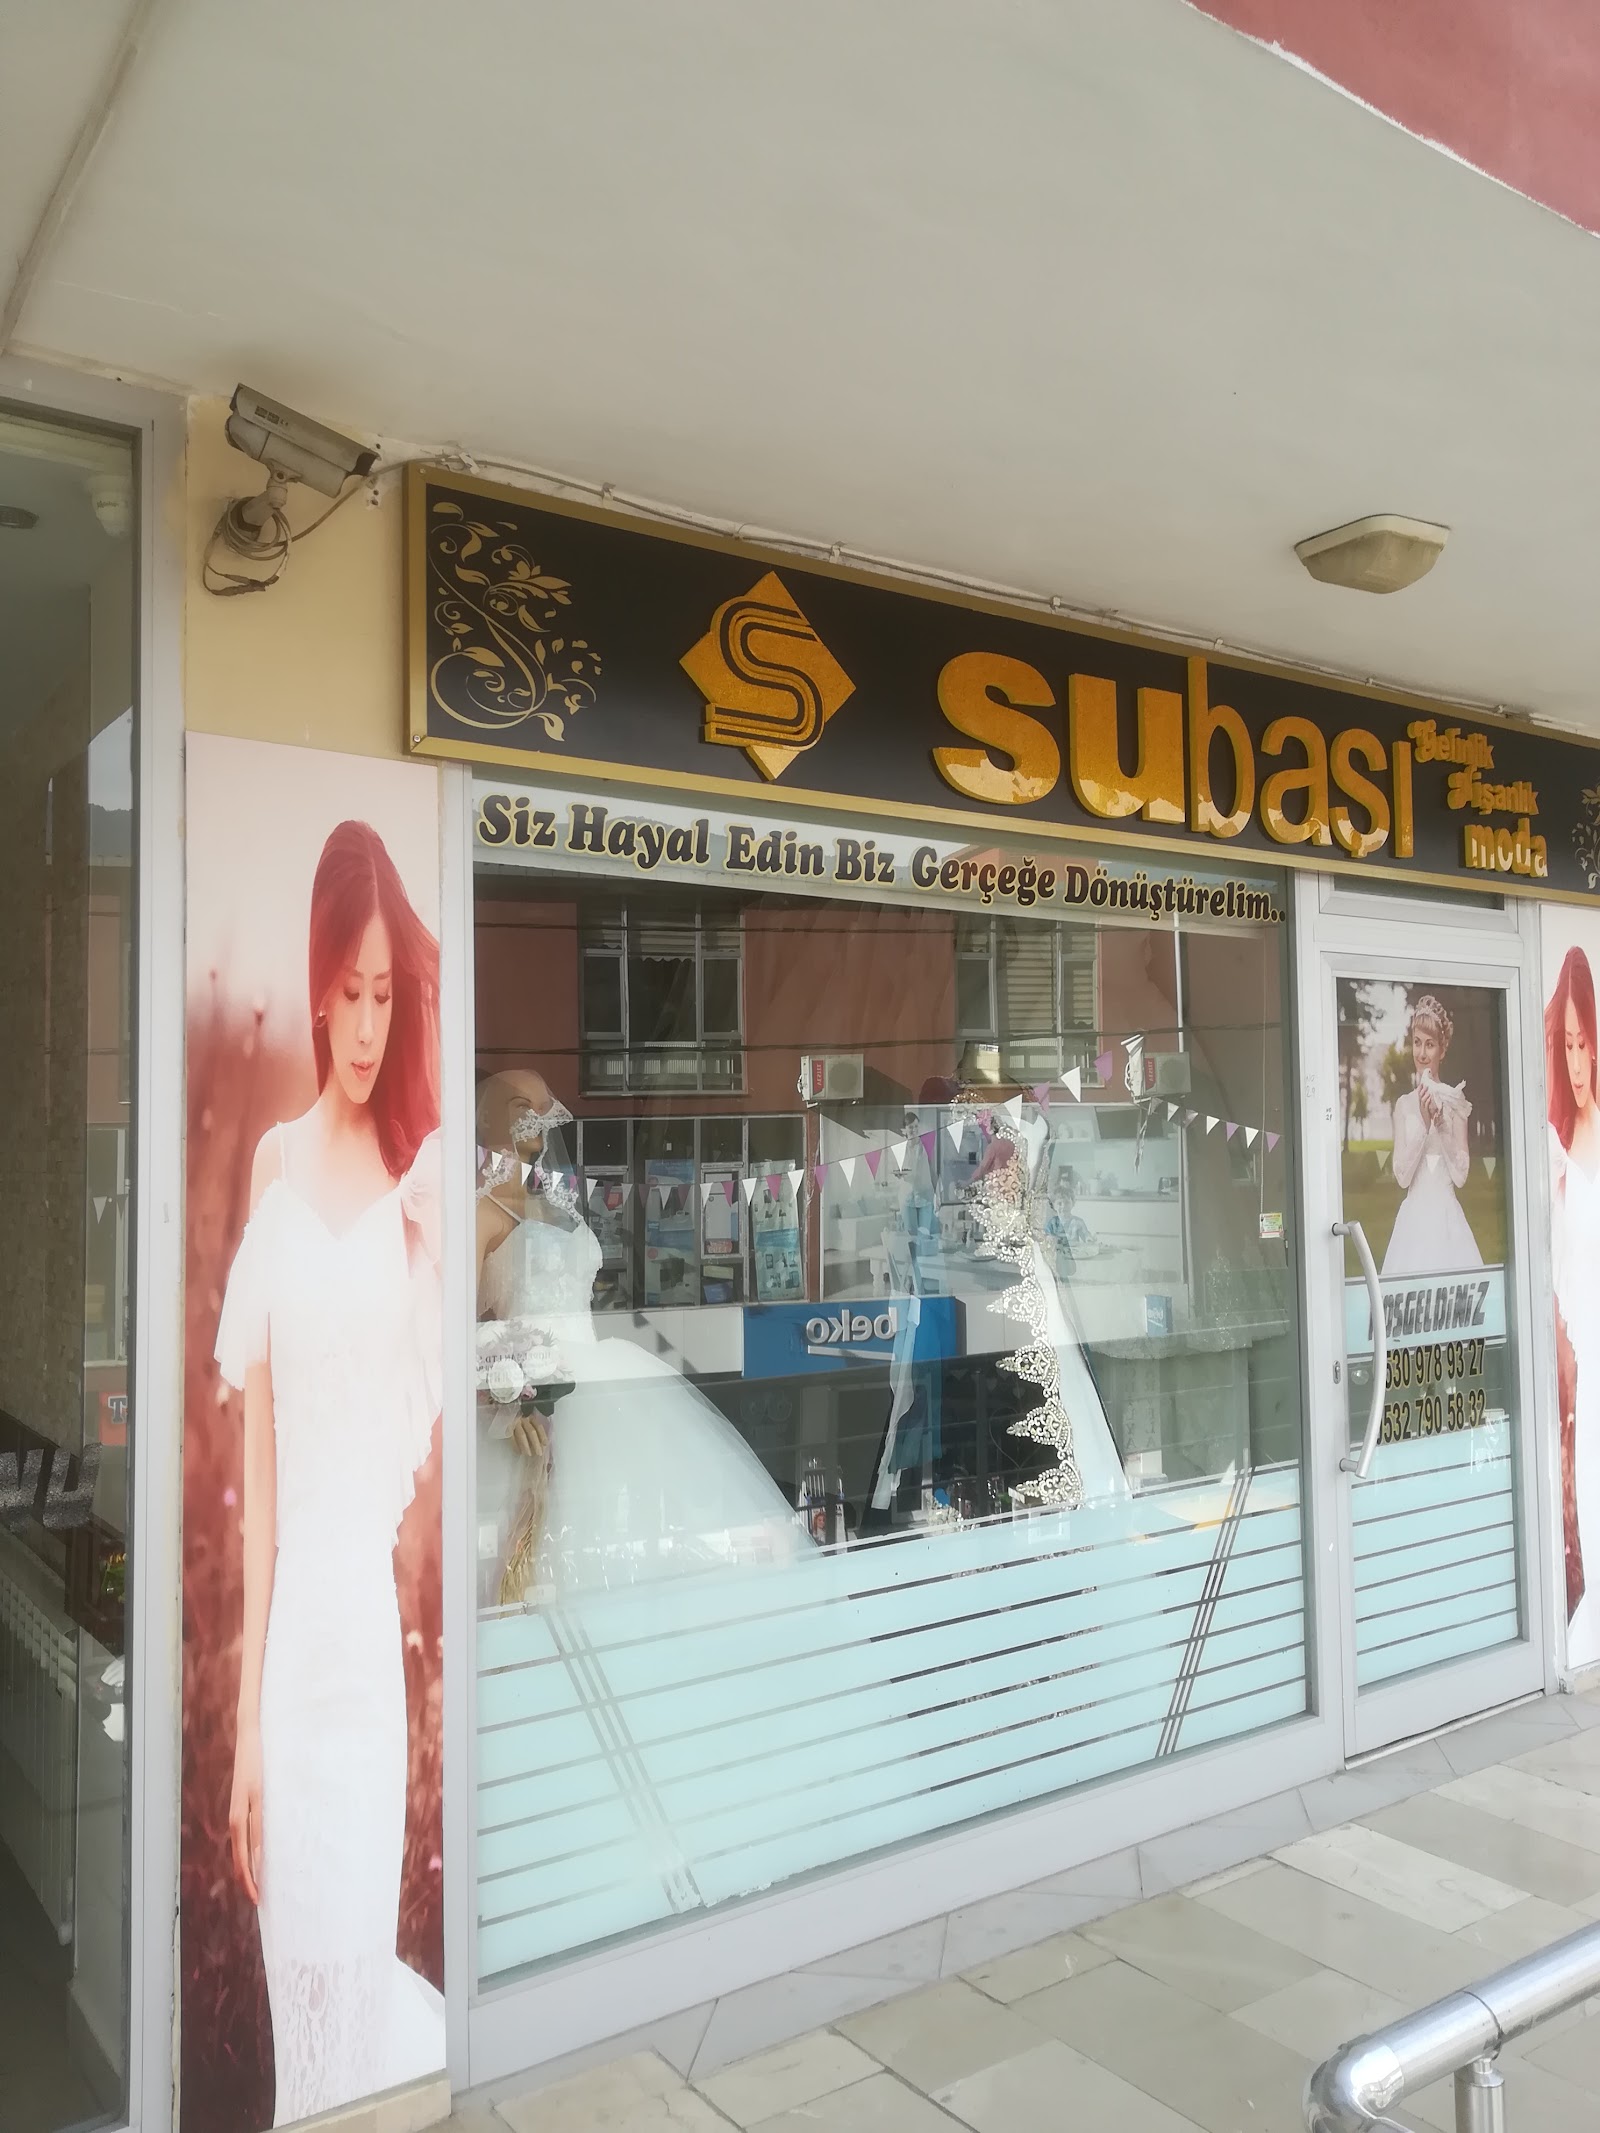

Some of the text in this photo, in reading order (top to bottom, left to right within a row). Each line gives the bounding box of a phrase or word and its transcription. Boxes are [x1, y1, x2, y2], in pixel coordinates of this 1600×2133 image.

[933, 651, 1415, 858] subaşı
[478, 793, 557, 846] Siz
[567, 803, 711, 870] Hayal
[725, 825, 825, 877] Edin
[834, 838, 896, 884] Biz
[912, 845, 1056, 906] Gerçeğe
[1464, 818, 1549, 878] moda
[1386, 1337, 1486, 1391] 530 978 93 27
[1415, 1395, 1442, 1438] 790
[1448, 1391, 1465, 1432] 58
[1469, 1387, 1487, 1429] 32
